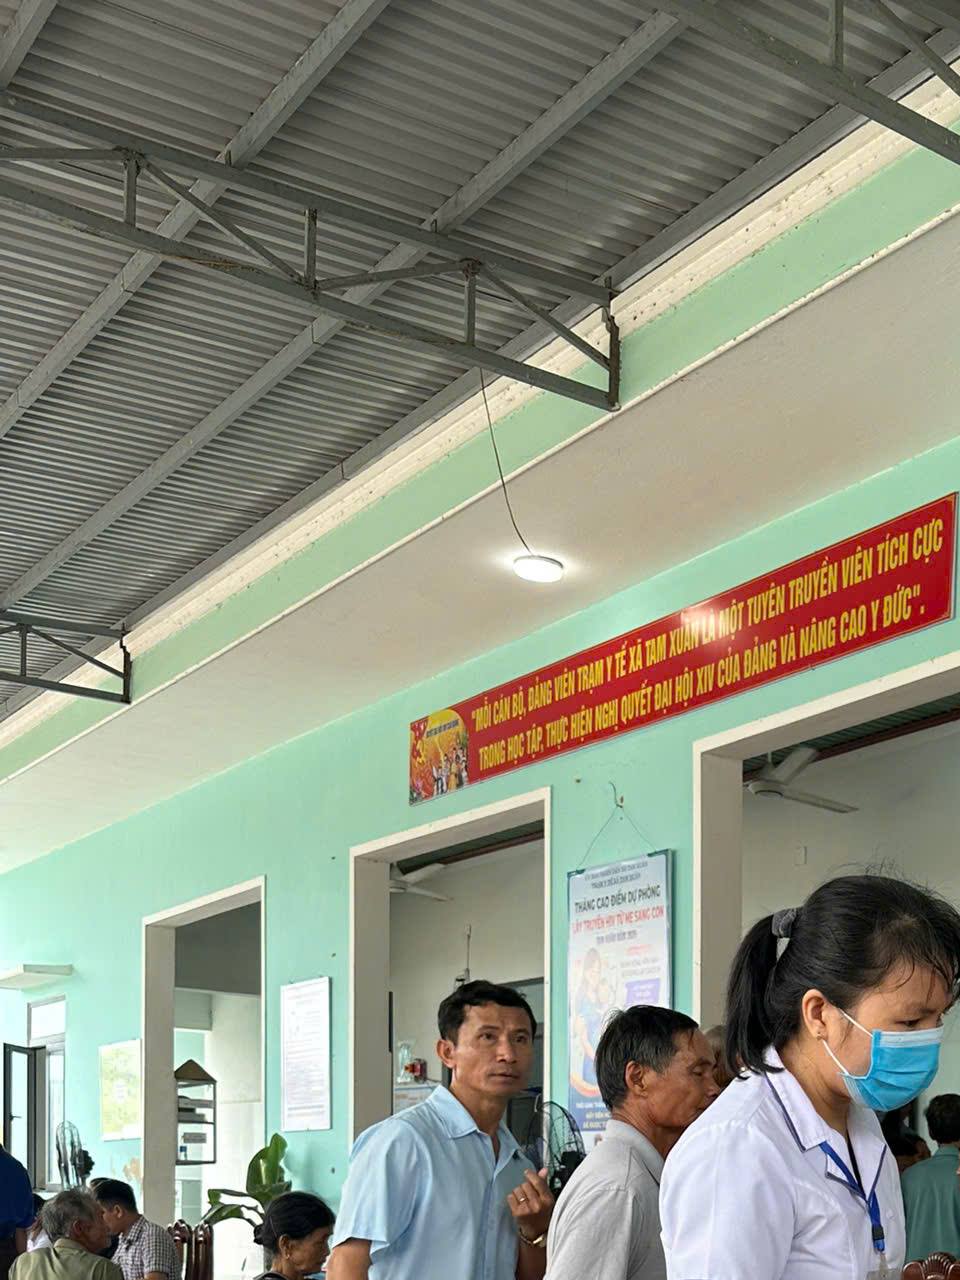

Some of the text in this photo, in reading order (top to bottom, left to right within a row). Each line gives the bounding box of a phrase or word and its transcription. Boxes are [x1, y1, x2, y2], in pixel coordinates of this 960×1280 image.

[479, 736, 506, 771] TRONG
[507, 731, 525, 765] HỌC
[546, 715, 569, 750] THỰC
[570, 705, 593, 741] HIỆN
[595, 698, 619, 731] NGHỊ
[620, 679, 652, 725] QUYẾT
[654, 681, 672, 713] ĐẠI
[675, 667, 693, 707] HỘI
[696, 663, 715, 697] XIV
[717, 647, 741, 689] CỦA
[743, 636, 777, 679] ĐẢNG
[780, 626, 797, 665] VÀ
[799, 617, 836, 658] NÂNG
[840, 605, 867, 644] CAO
[871, 599, 882, 632] Y
[493, 689, 511, 725] CÁN
[512, 685, 527, 721] BỘ,
[528, 676, 553, 712] ĐẢNG
[554, 668, 575, 701] VIÊN
[576, 660, 604, 695] TRẠM
[606, 655, 613, 682] Y
[615, 640, 628, 677] TẾ
[629, 638, 644, 673] XÃ
[645, 634, 667, 667] TAM
[669, 620, 699, 659] XUÂN
[702, 611, 716, 646] LÀ
[719, 599, 744, 640] MỘT
[747, 583, 786, 627] TUYÊN
[789, 555, 838, 610] TRUYỀN
[842, 546, 873, 589] VIÊN
[877, 533, 909, 575] TÍCH
[912, 518, 944, 563] CỰC
[574, 883, 661, 914] THÁNG CAO ĐIỂM DỰ PHÒNG
